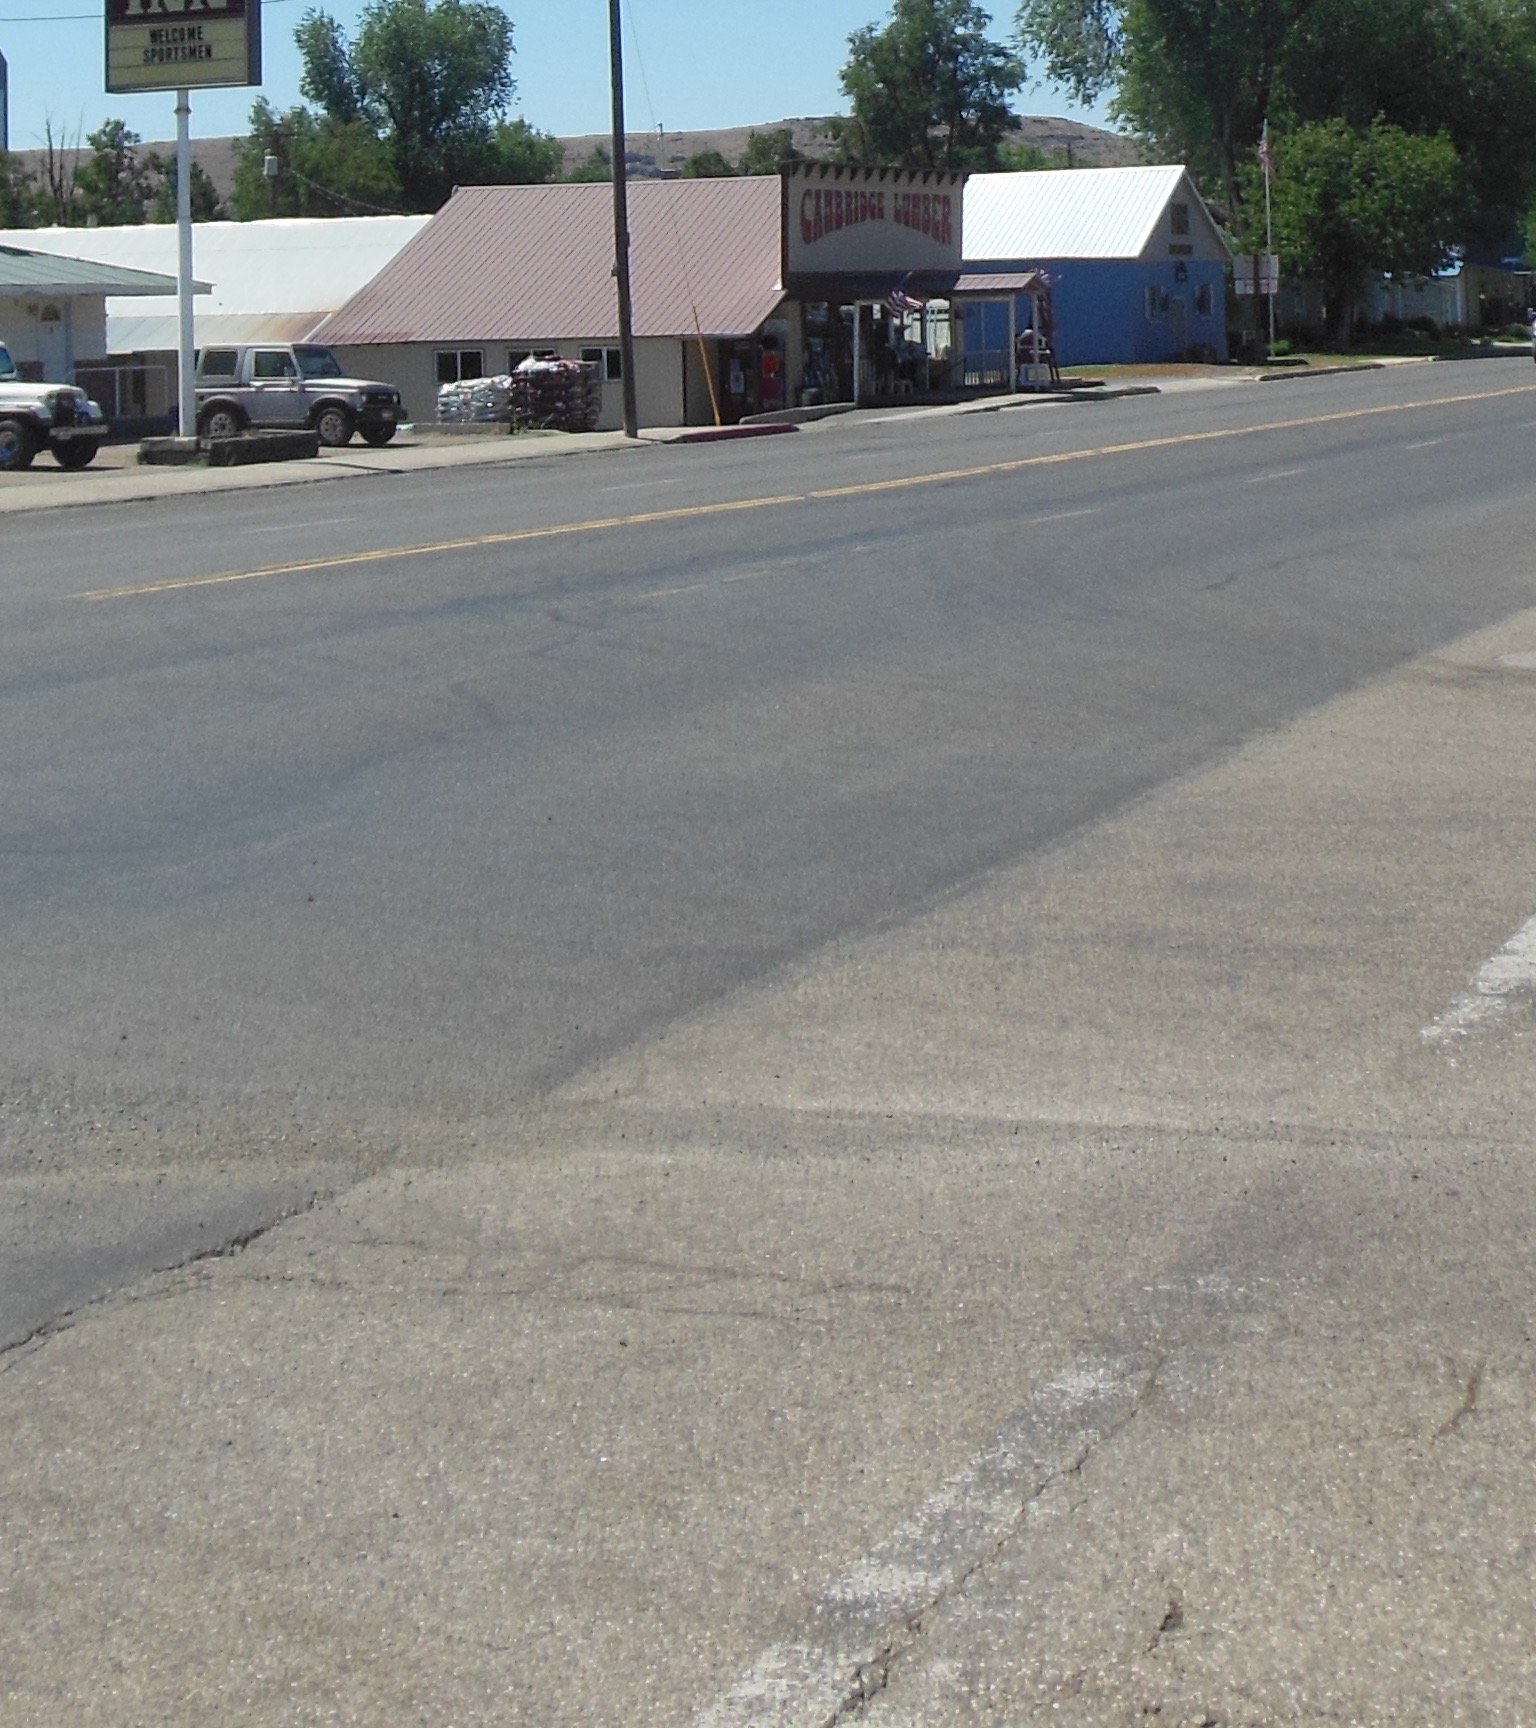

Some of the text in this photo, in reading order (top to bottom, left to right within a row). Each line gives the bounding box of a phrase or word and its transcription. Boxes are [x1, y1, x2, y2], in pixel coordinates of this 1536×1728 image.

[150, 25, 204, 44] WELCOME
[143, 44, 213, 63] SPORTSMEN
[800, 188, 952, 246] CAMBRIDGE LUMBER
